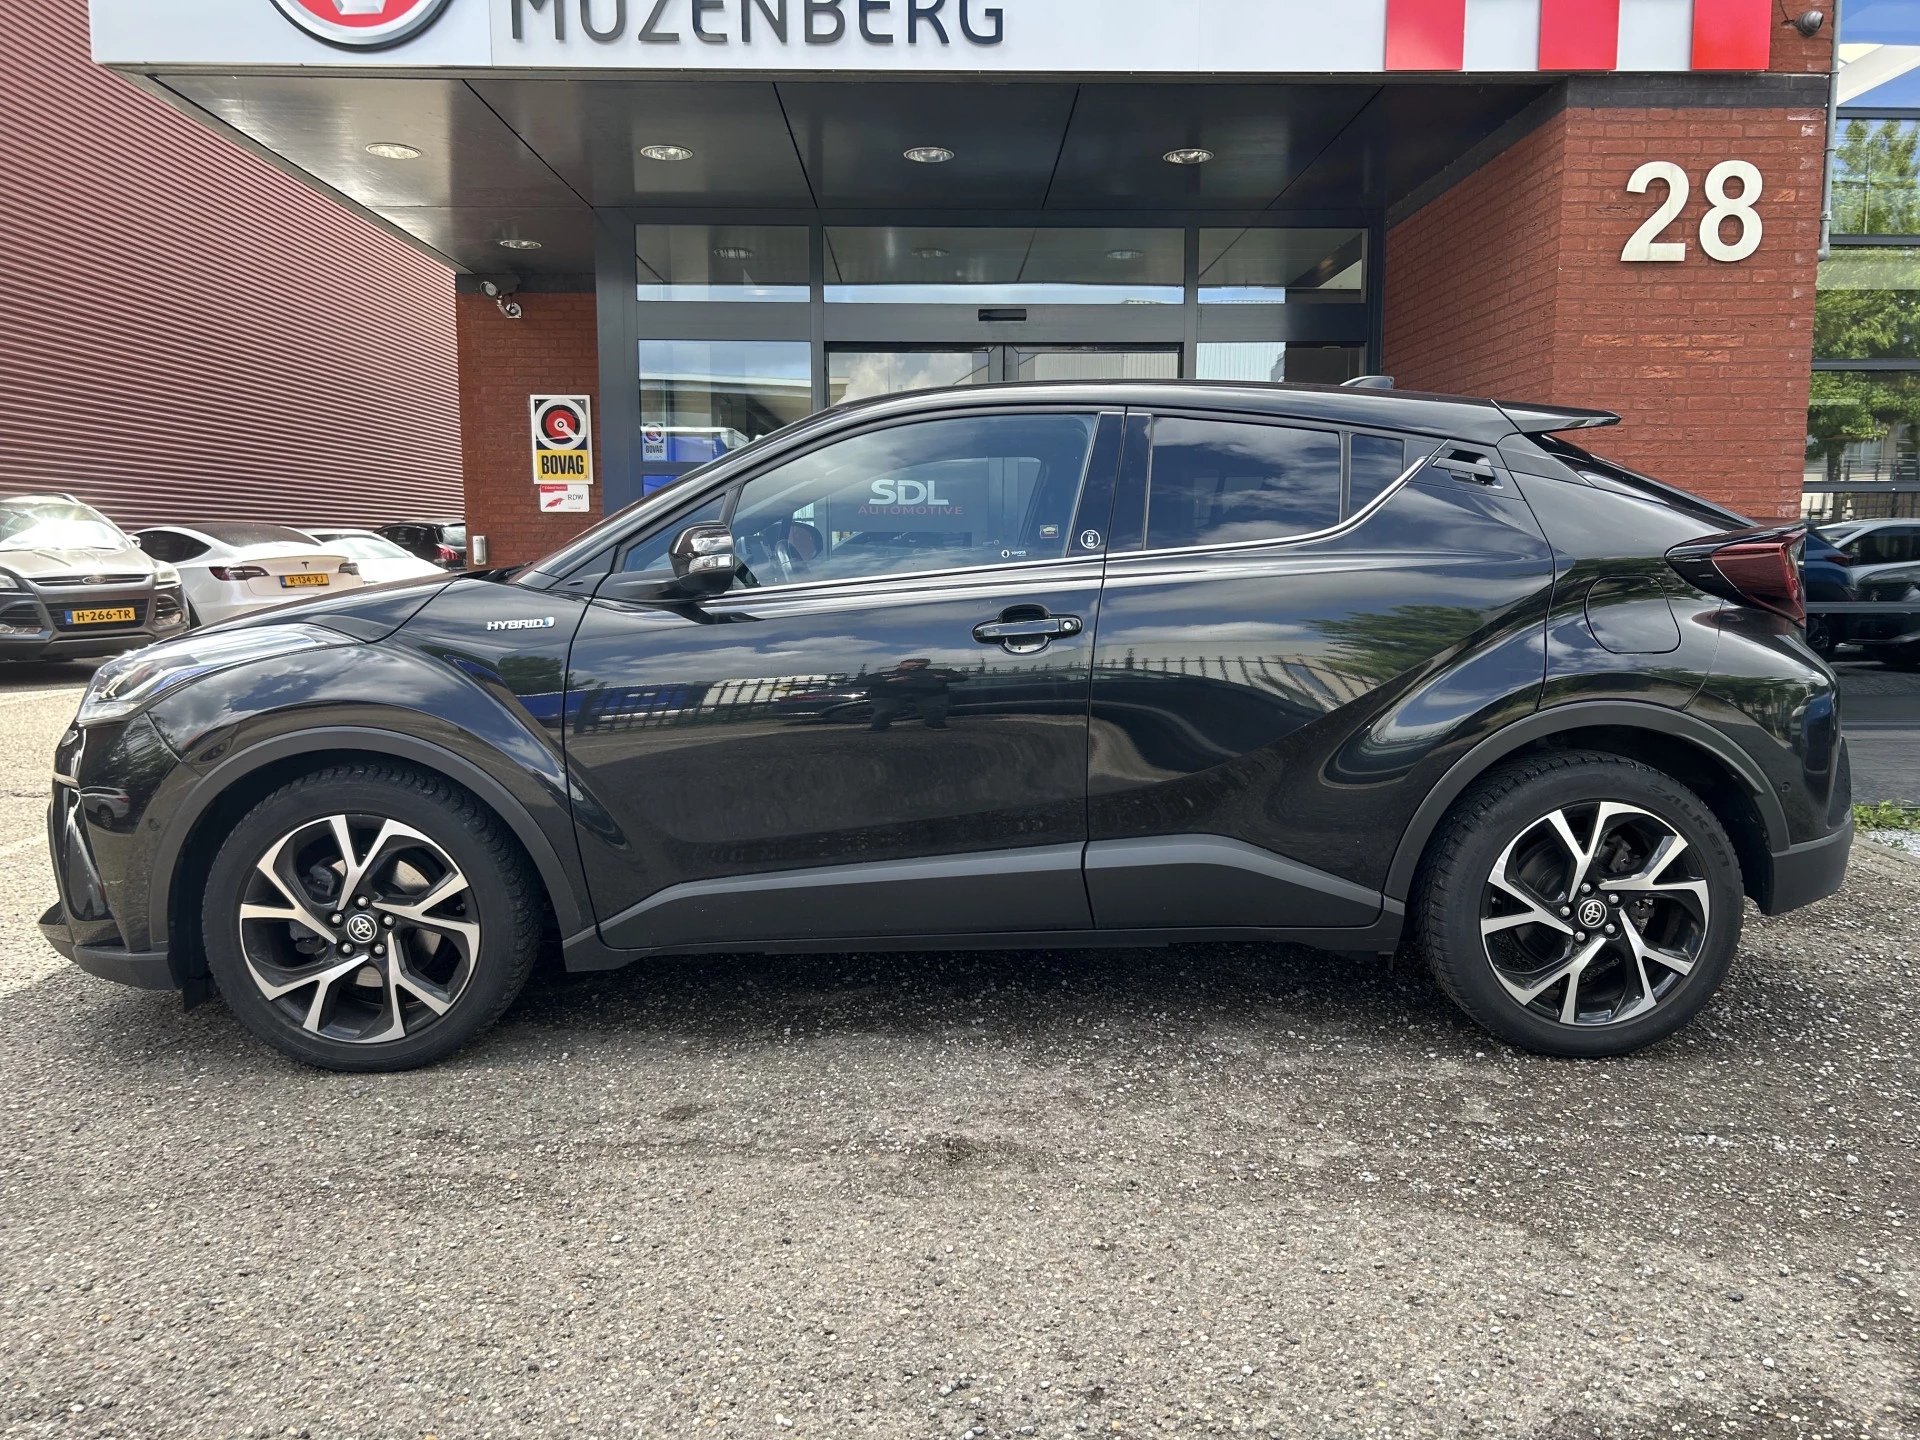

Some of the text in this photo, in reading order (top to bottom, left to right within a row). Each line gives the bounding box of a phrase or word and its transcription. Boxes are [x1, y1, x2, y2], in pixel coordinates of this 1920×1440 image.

[1620, 159, 1764, 262] 28
[541, 454, 585, 475] BOVAG
[868, 479, 949, 505] SDL
[858, 506, 964, 515] AUTOMOTIVE
[289, 575, 324, 585] R-134-XJ
[76, 609, 131, 622] H-266-TR
[486, 618, 544, 631] HYBRID
